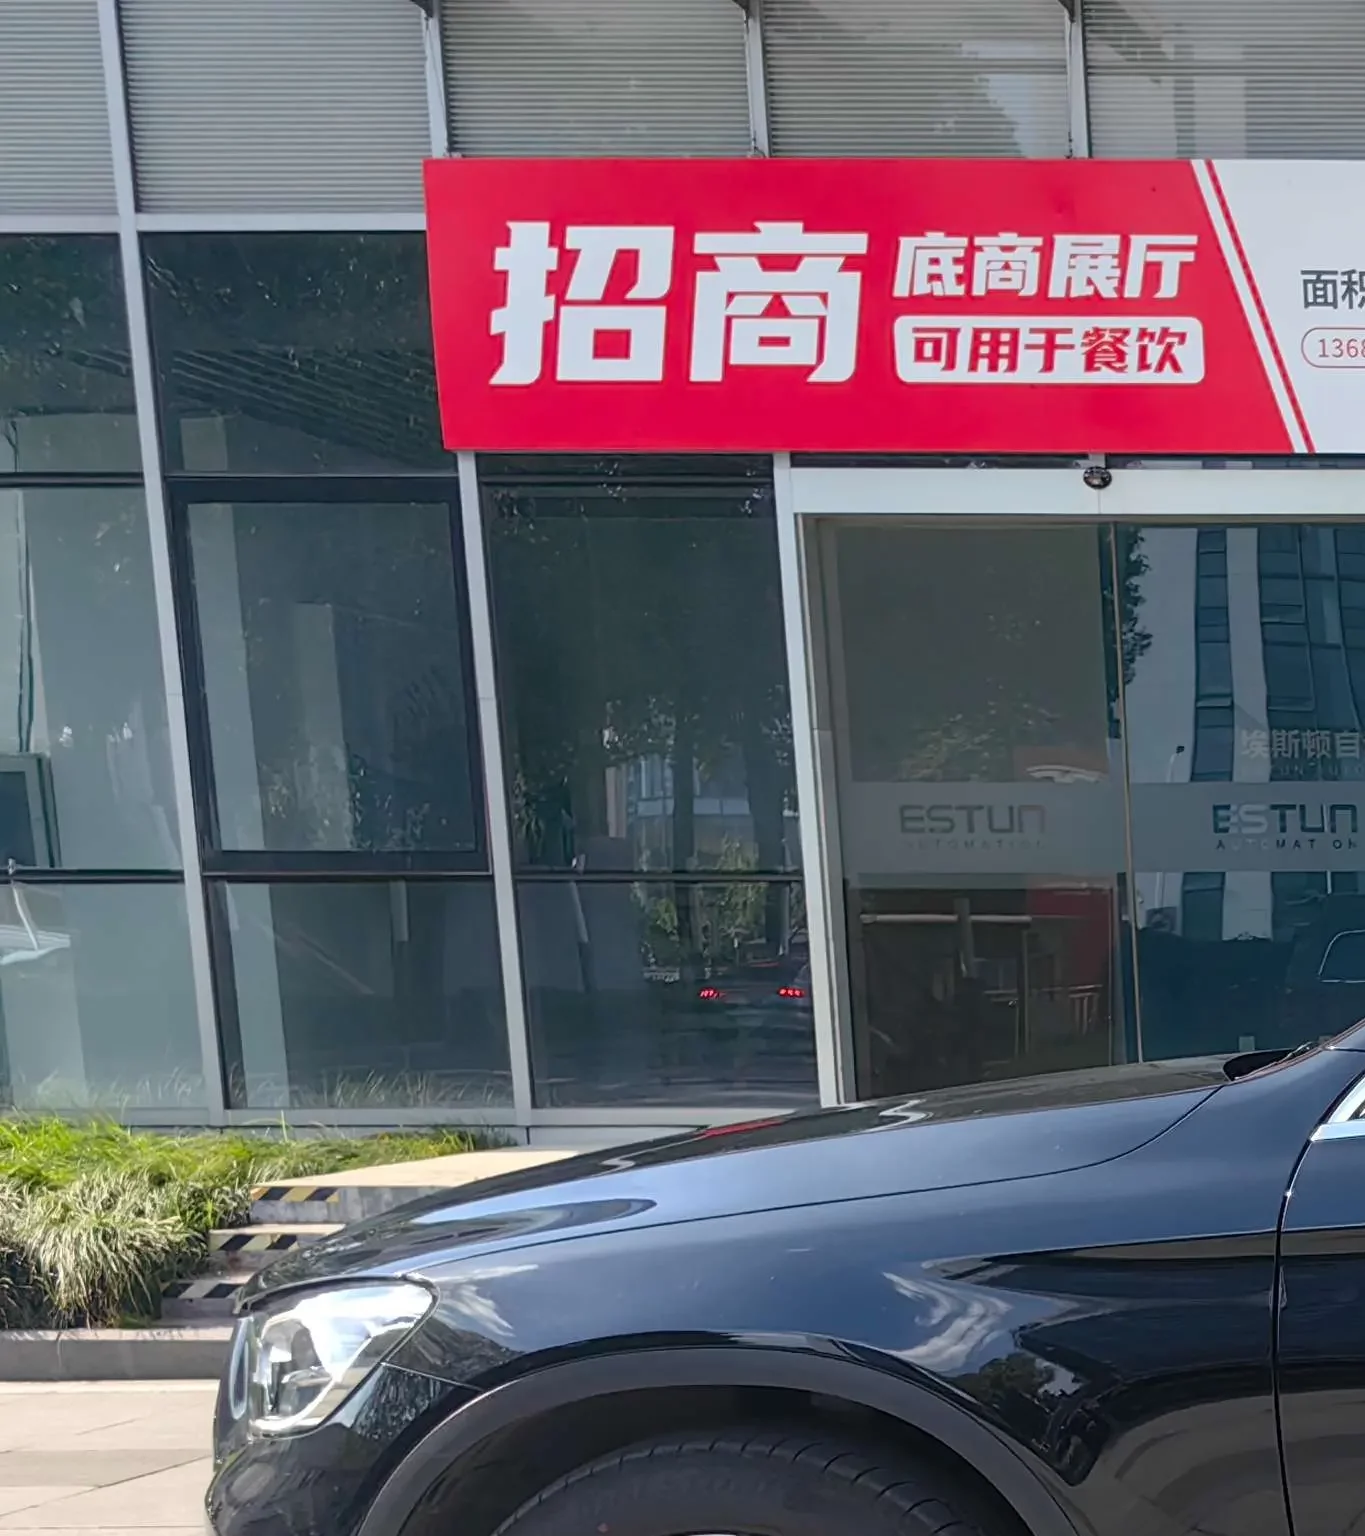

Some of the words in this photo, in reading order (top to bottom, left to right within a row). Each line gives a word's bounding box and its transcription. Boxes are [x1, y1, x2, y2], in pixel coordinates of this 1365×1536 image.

[892, 231, 1199, 299] 底商展厅
[488, 220, 870, 385] 招商
[912, 326, 1187, 375] 可用于餐饮
[898, 804, 1048, 834] ESTUN
[1212, 803, 1359, 834] ESTUN
